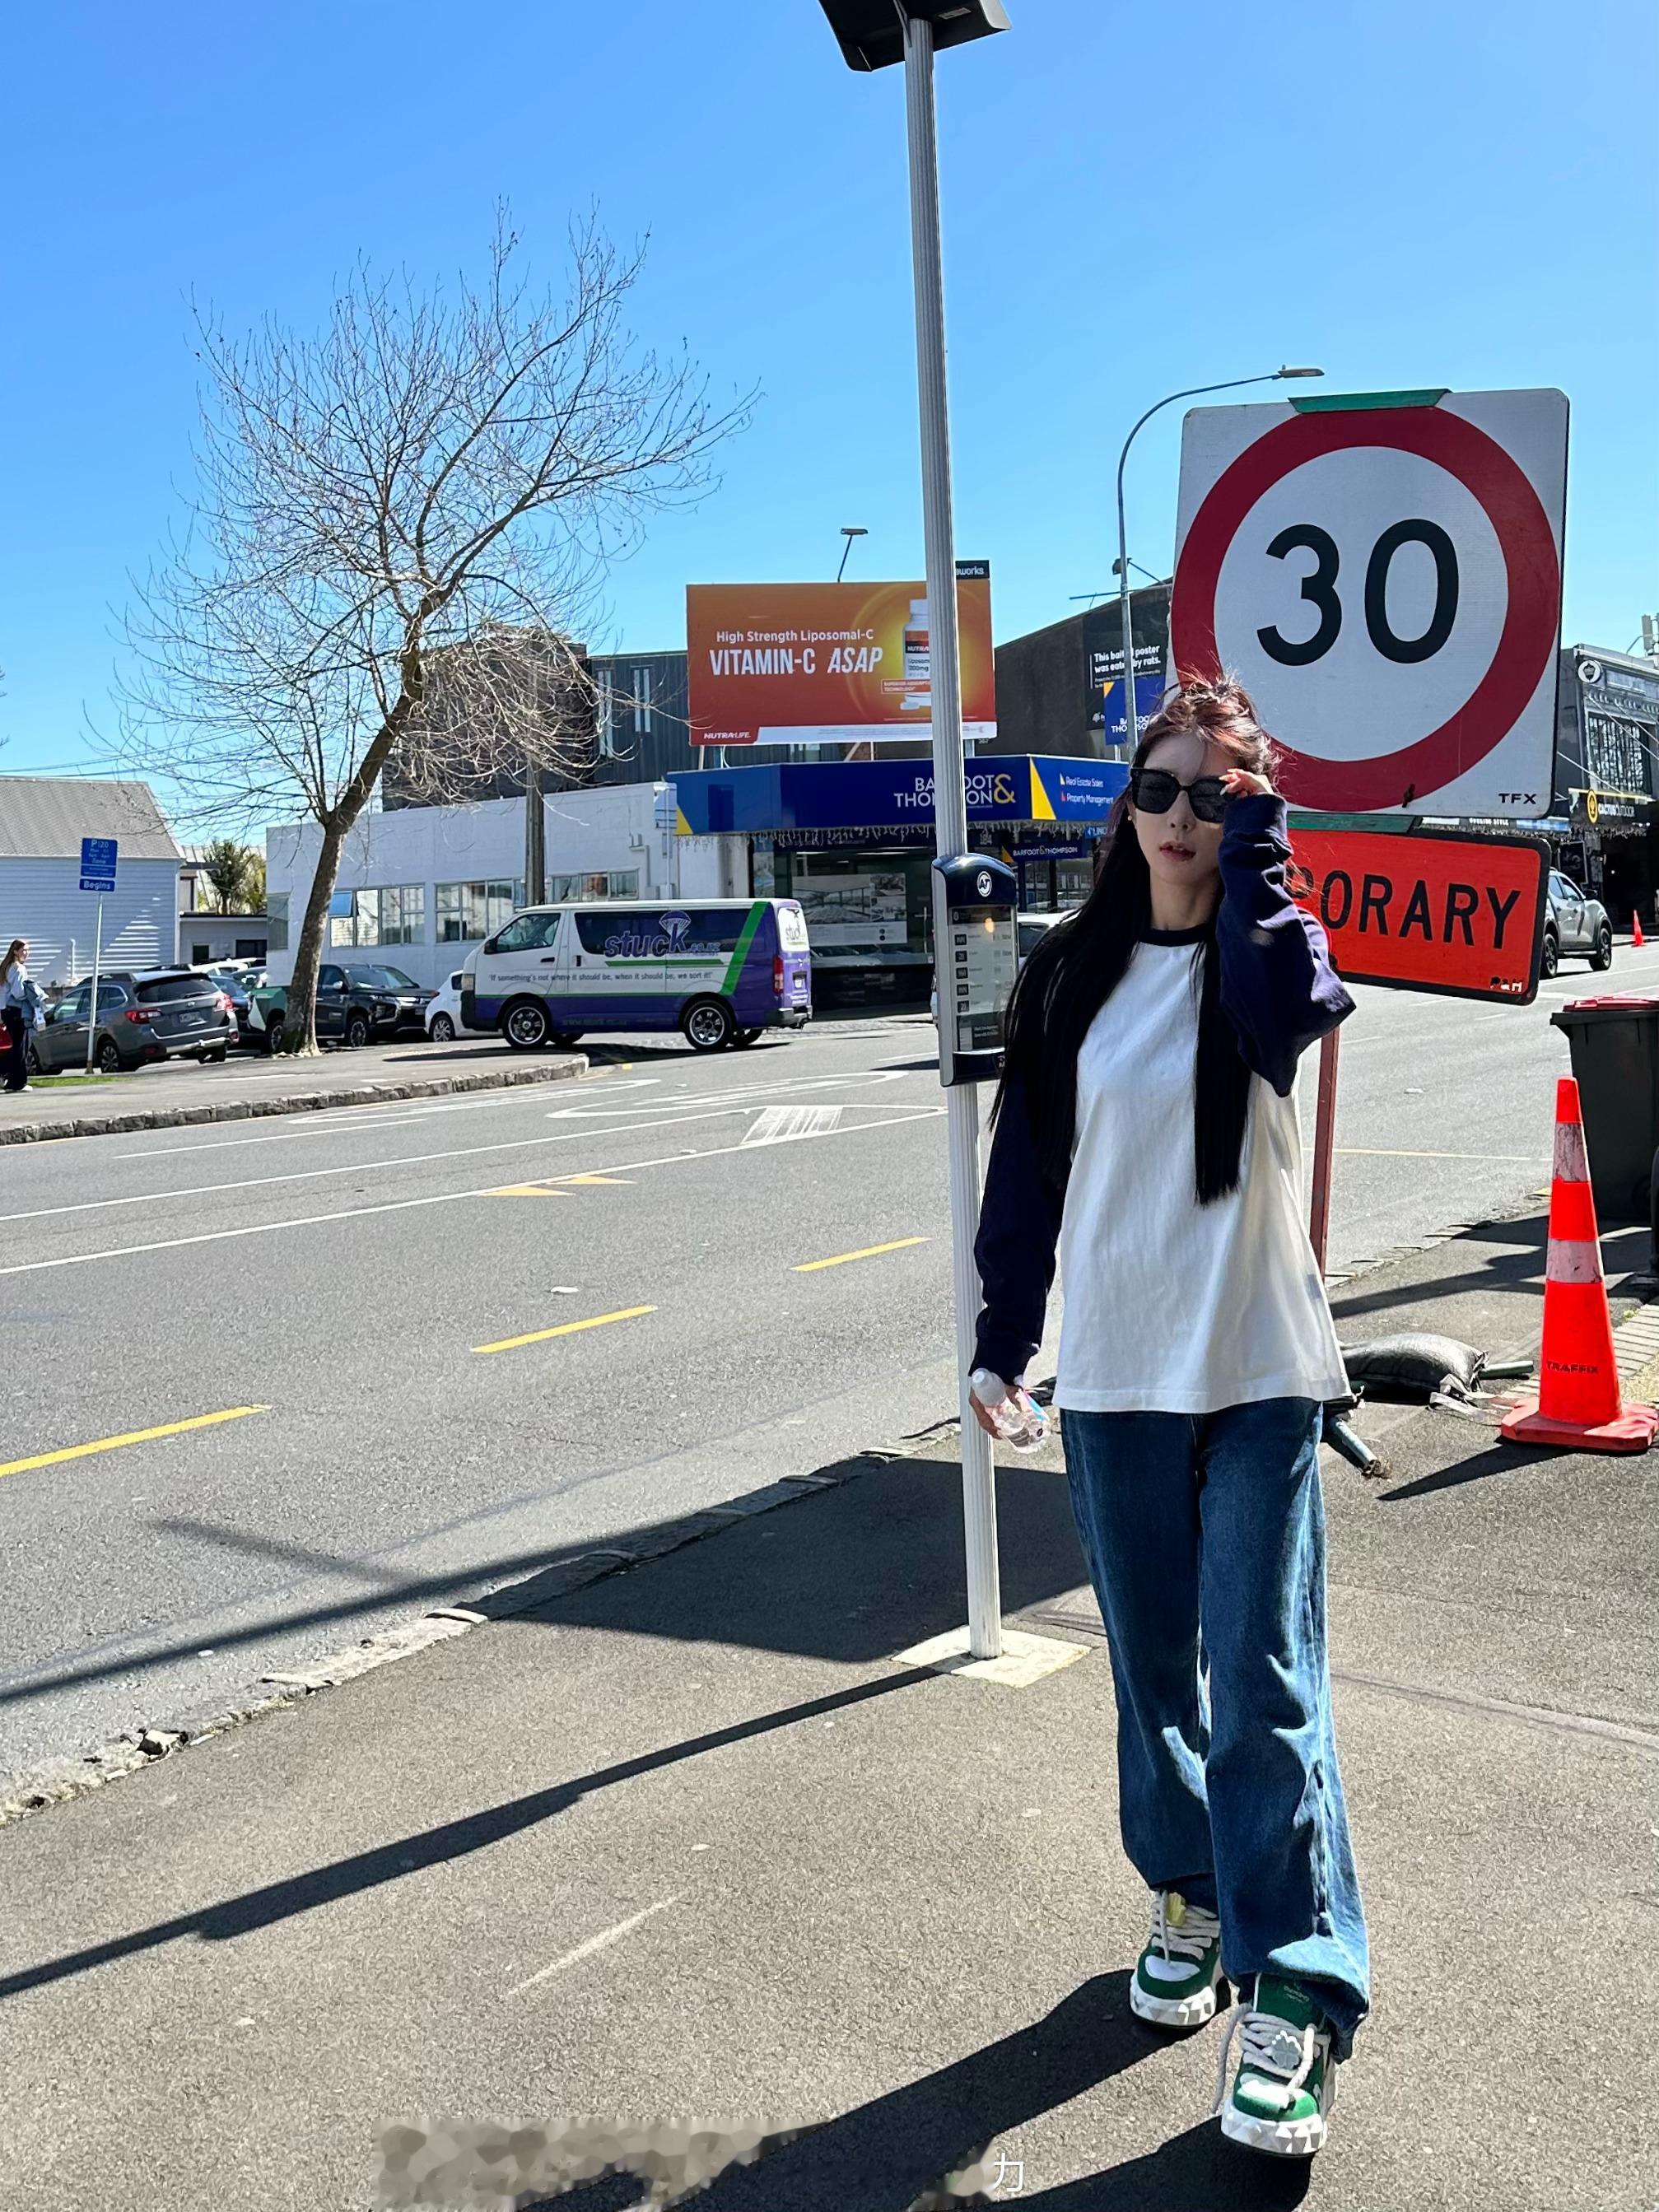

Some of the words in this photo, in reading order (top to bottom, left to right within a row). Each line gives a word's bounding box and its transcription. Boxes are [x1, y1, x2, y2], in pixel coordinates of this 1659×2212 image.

[1256, 519, 1460, 667] 30
[716, 631, 743, 644] High
[746, 630, 798, 644] Strength
[799, 628, 874, 643] Liposomal-C
[709, 647, 816, 676] VITAMIN-C
[827, 646, 883, 674] ASAP
[1093, 653, 1110, 662] This
[1135, 645, 1161, 659] poster
[1095, 664, 1110, 673] was
[1144, 656, 1162, 666] rats.
[1498, 793, 1537, 804] TFX
